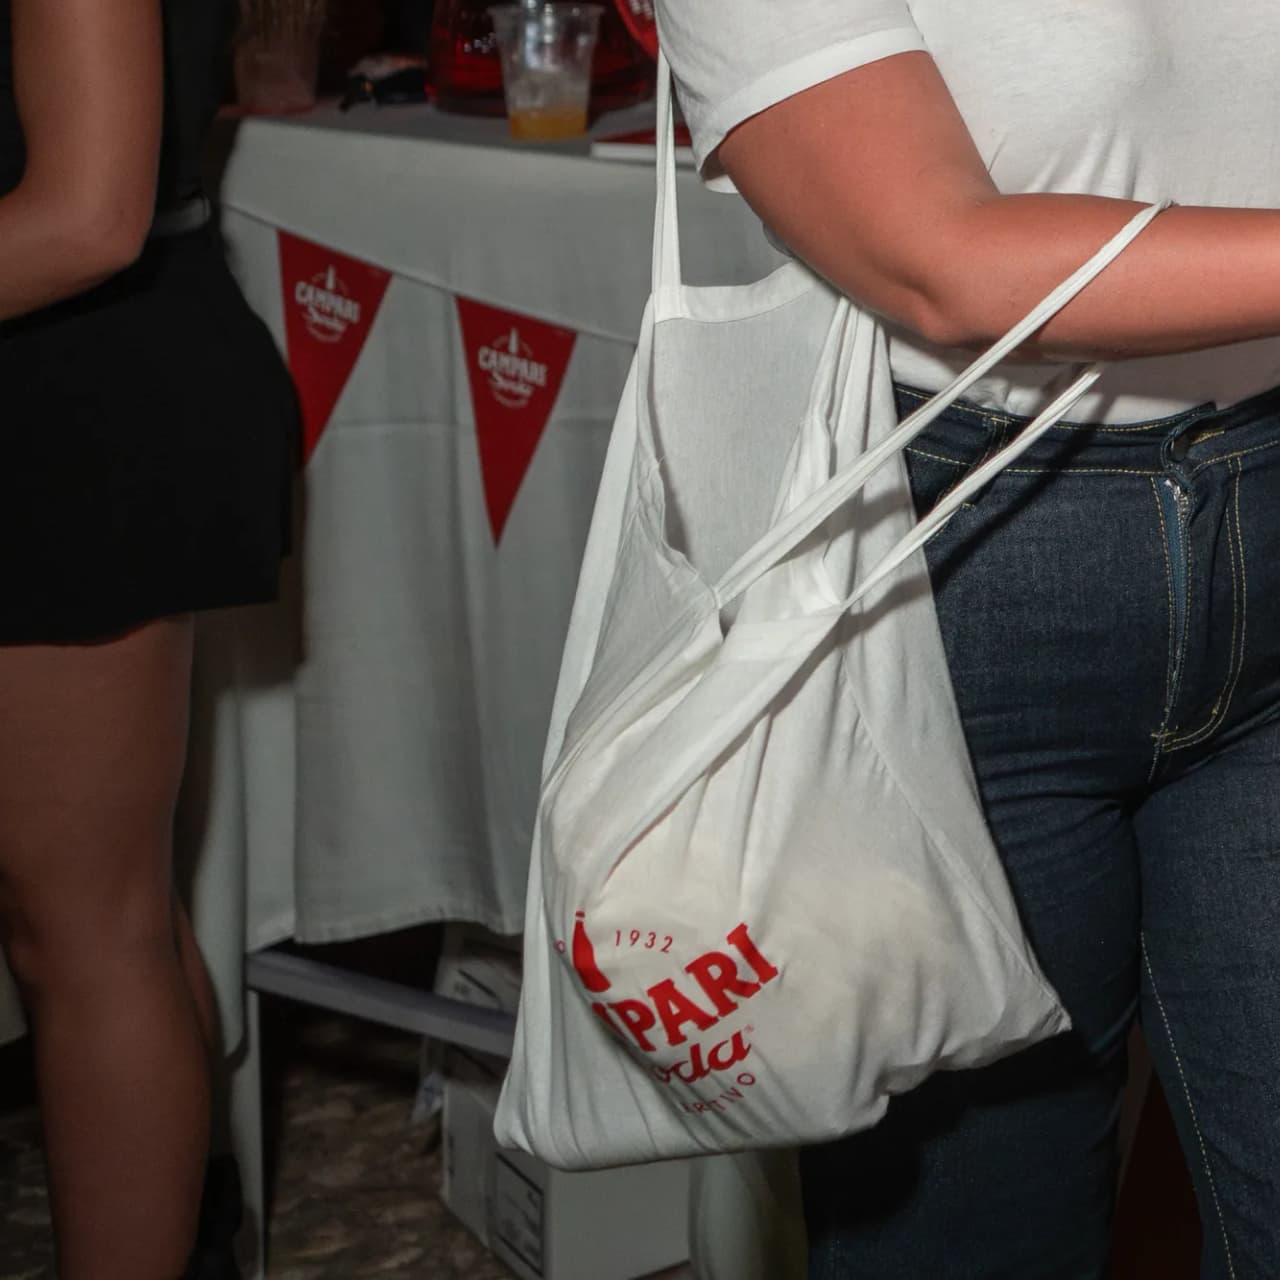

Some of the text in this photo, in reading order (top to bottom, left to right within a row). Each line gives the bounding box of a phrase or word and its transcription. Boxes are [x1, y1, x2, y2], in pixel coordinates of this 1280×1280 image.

[478, 345, 548, 387] CAMPARI
[615, 929, 673, 954] 1932
[591, 922, 779, 1053] PARI
